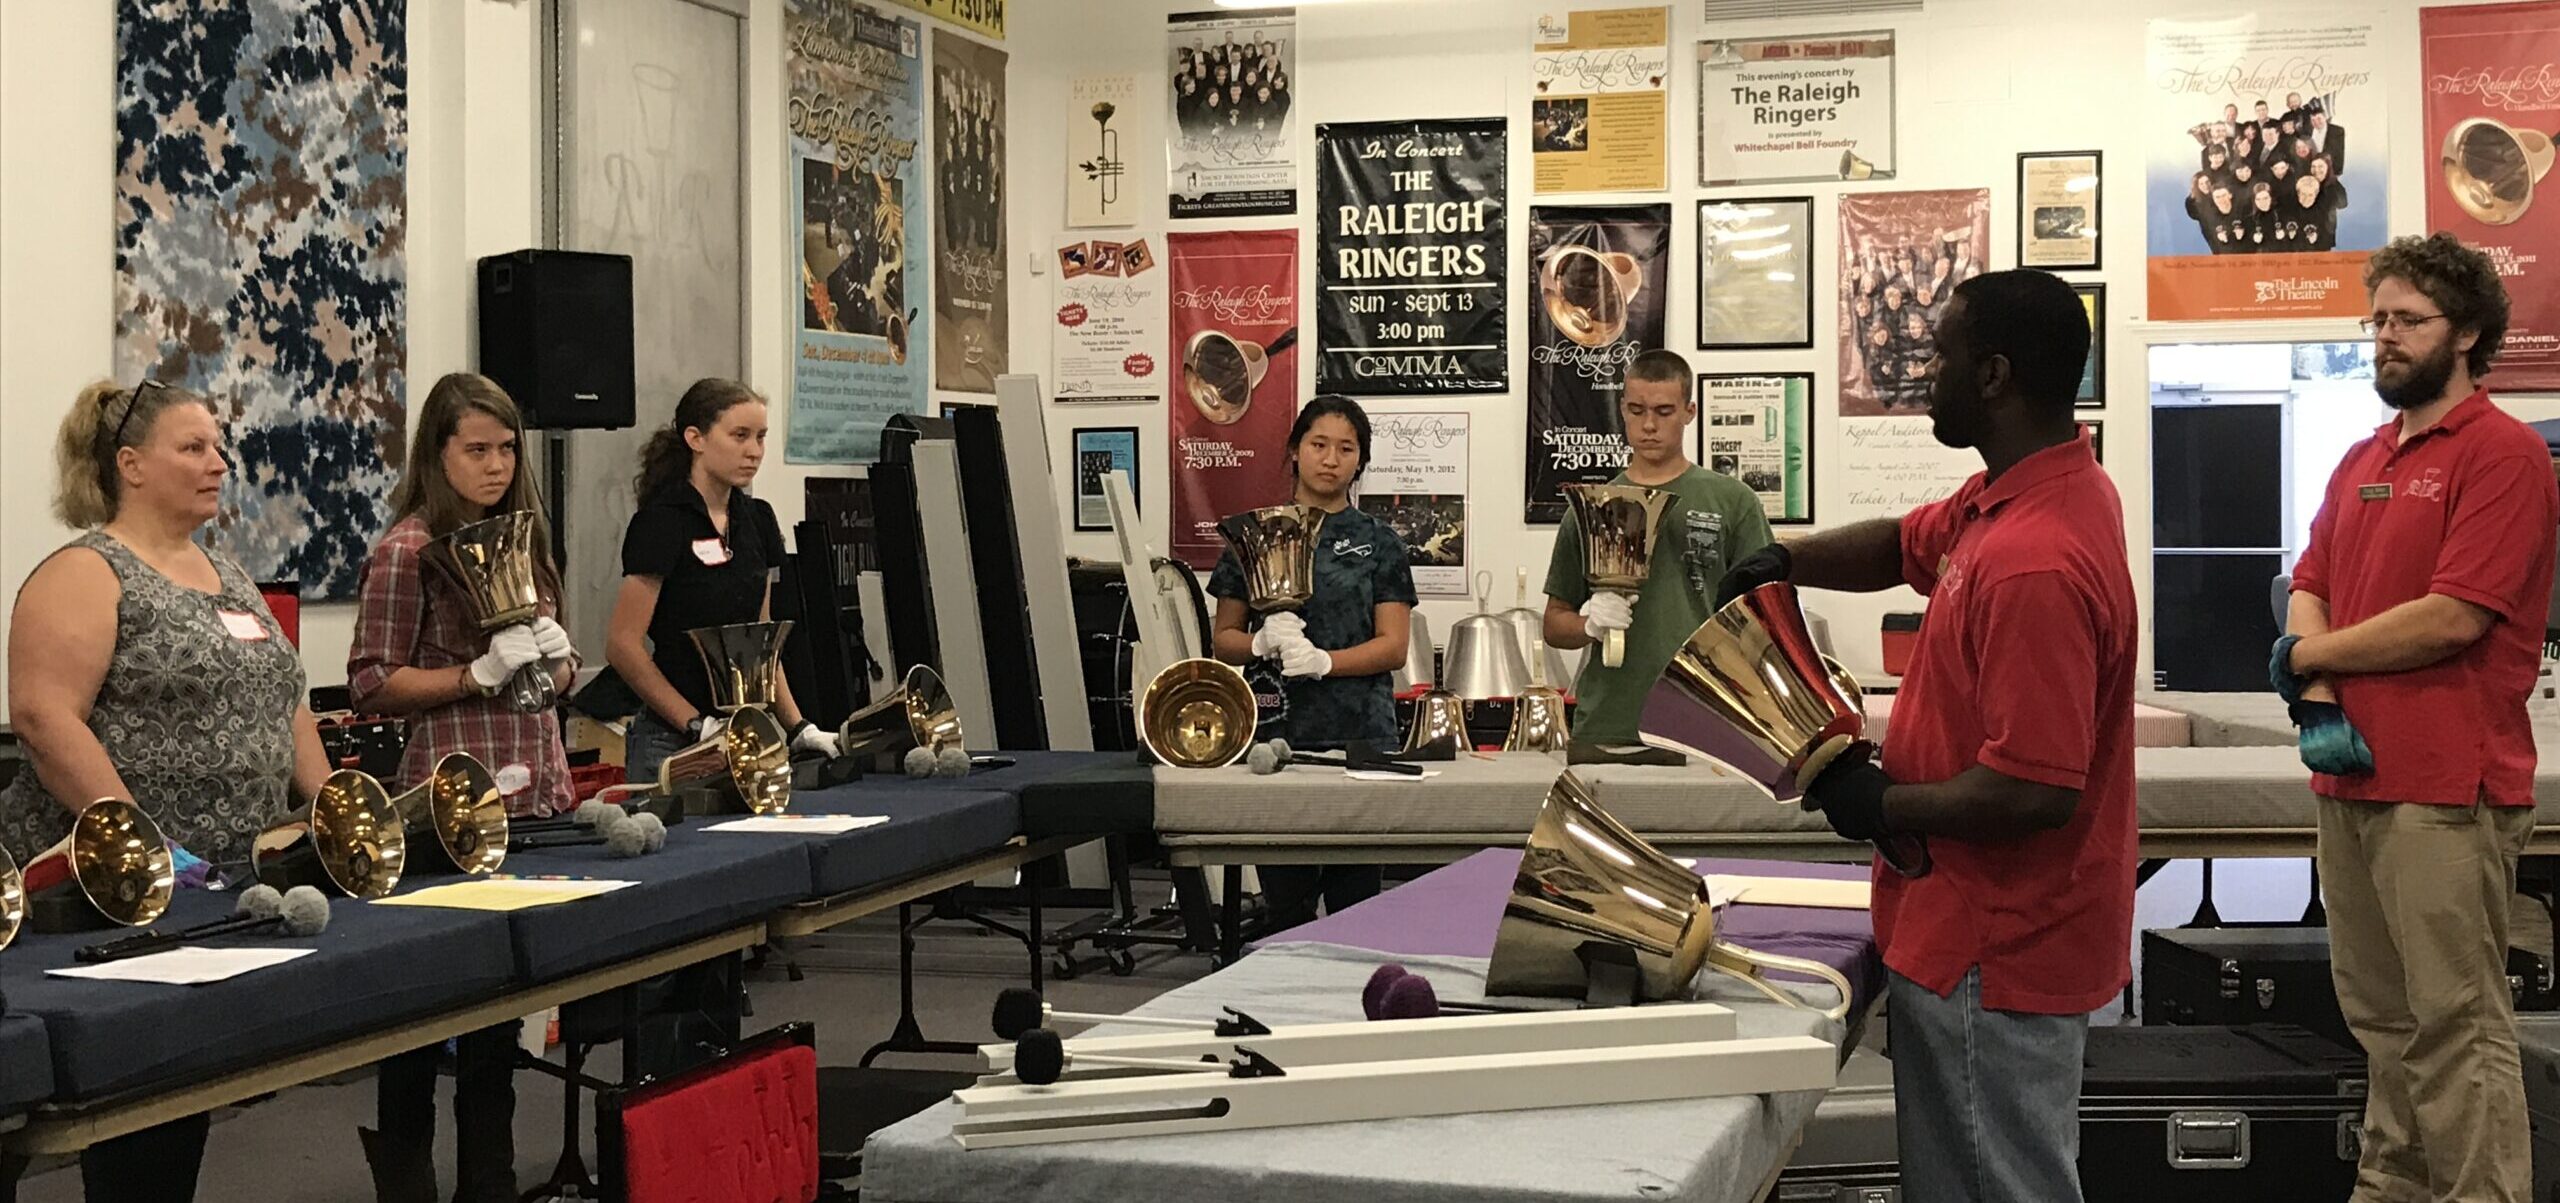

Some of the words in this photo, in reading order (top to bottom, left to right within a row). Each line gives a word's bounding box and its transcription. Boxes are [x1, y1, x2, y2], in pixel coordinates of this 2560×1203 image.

[1533, 50, 1571, 77] The
[1562, 49, 1617, 93] Raleigh
[1613, 49, 1665, 86] Ringers
[1736, 73, 1756, 83] This
[1757, 71, 1802, 82] evening's
[1803, 69, 1841, 79] concert
[1842, 67, 1855, 78] by
[2157, 57, 2214, 94] The
[2205, 57, 2290, 98] Raleigh
[2286, 55, 2371, 95] Ringers
[1731, 86, 1772, 105] The
[1777, 80, 1861, 105] Raleigh
[2428, 66, 2471, 95] The
[2463, 66, 2528, 111] Raleigh
[789, 92, 820, 139] The
[1753, 106, 1837, 128] Ringers
[1775, 130, 1812, 140] presented
[1812, 129, 1823, 139] by
[1360, 139, 1387, 160] In
[1394, 139, 1464, 160] Concert
[1734, 141, 1795, 154] Whitechapel
[1796, 140, 1815, 150] Bell
[1816, 138, 1858, 150] Foundry
[1390, 170, 1433, 192] THE
[1338, 200, 1485, 236] RALEIGH
[1338, 243, 1486, 279] RINGERS
[2274, 278, 2293, 290] The
[2291, 276, 2339, 290] Lincoln
[1457, 292, 1474, 312] 13
[2280, 287, 2327, 301] Theatre
[1173, 285, 1206, 309] The
[1199, 285, 1250, 325] Raleigh
[1246, 284, 1293, 319] Ringers
[1377, 322, 1412, 340] 3:00
[1417, 323, 1445, 343] pm
[2505, 335, 2560, 344] DANIEL
[1532, 339, 1570, 364] The
[1561, 344, 1616, 382] Raleigh
[1591, 382, 1625, 391] Handbell
[1381, 417, 1427, 453] Raleigh
[1422, 416, 1466, 449] Ringers
[1542, 429, 1624, 447] SATURDAY,
[1561, 425, 1588, 434] Concert
[1846, 420, 1887, 446] Keppel
[1178, 439, 1234, 452] SATURDAY,
[1558, 443, 1616, 454] DECEMBER
[1711, 441, 1742, 452] CONCERT
[1184, 456, 1213, 470] 7:30
[1214, 456, 1242, 468] P.M.
[1367, 465, 1403, 475] Saturday,
[1405, 465, 1422, 475] May
[1424, 465, 1436, 474] 19,
[1437, 464, 1457, 473] 2012
[1550, 452, 1592, 471] 7:30
[1595, 453, 1633, 468] P.M.
[1848, 488, 1887, 505] Tickets
[1194, 521, 1219, 529] JOH
